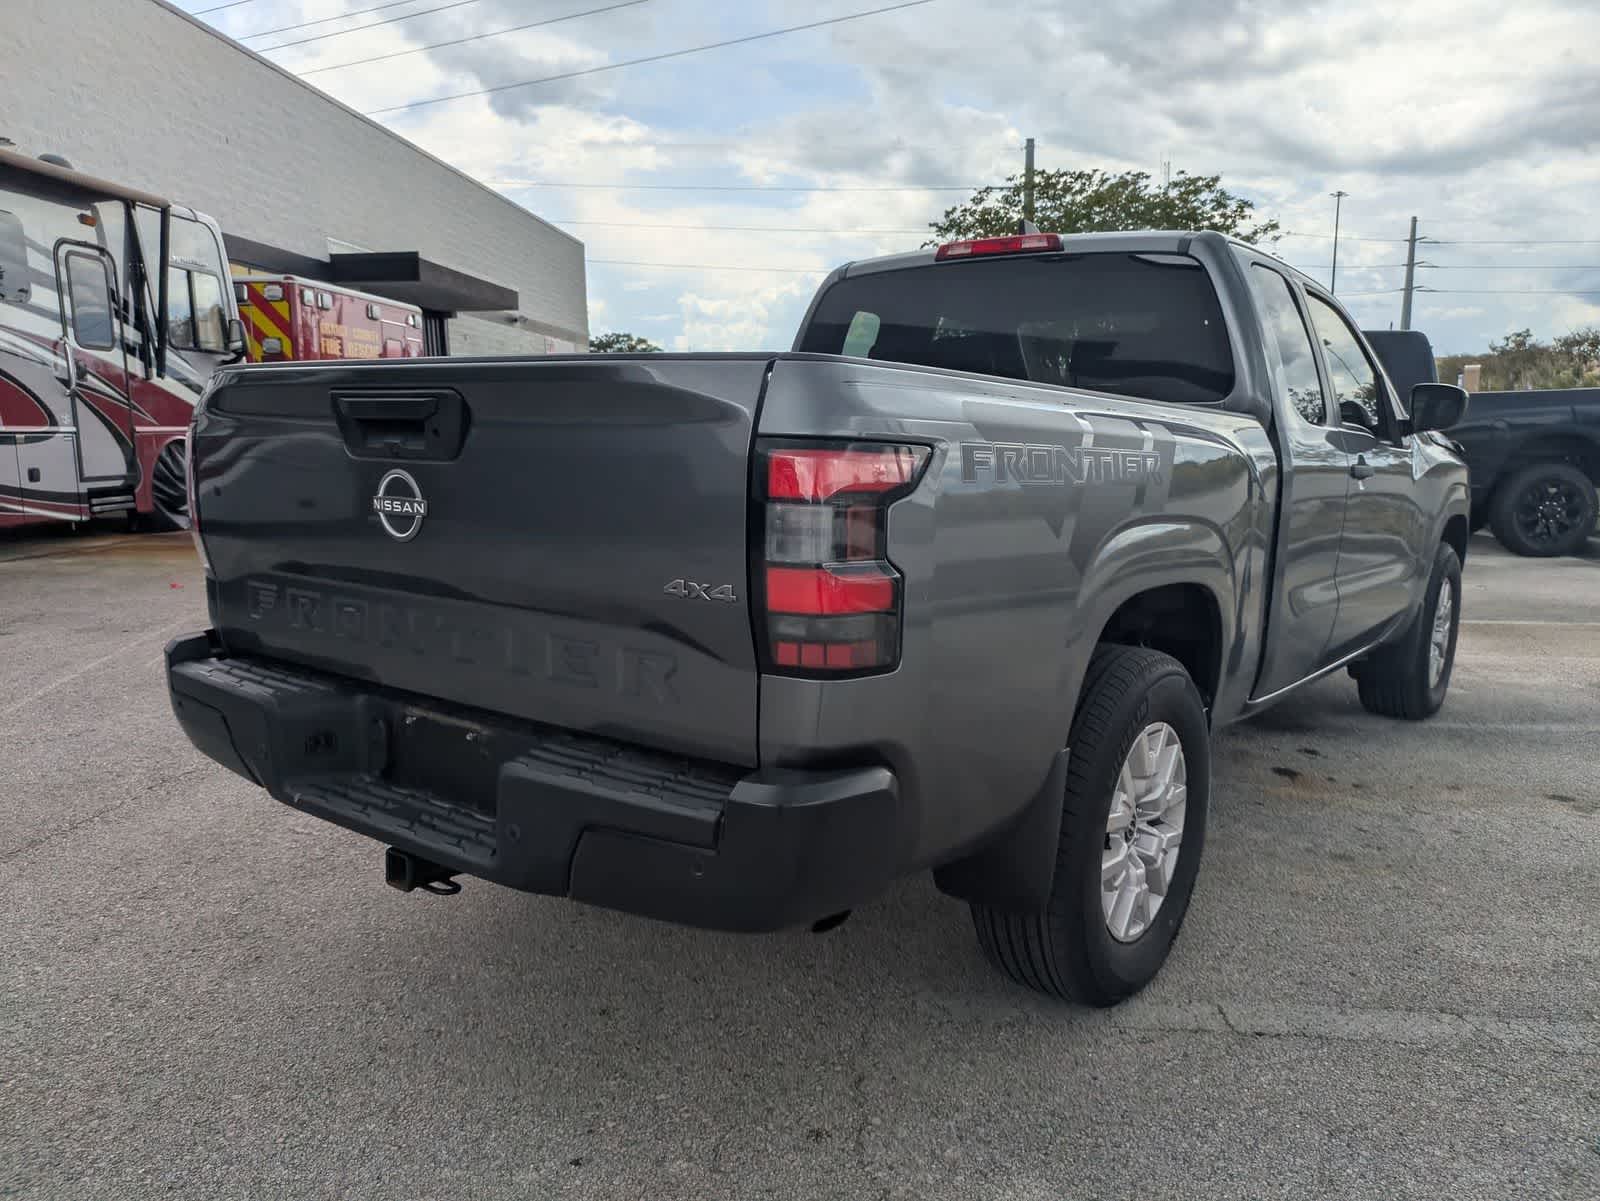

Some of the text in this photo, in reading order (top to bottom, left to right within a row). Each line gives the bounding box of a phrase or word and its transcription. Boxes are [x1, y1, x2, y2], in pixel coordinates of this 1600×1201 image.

[320, 337, 342, 356] FIRE
[960, 441, 1161, 487] FRONTIER
[373, 498, 425, 514] NISSAN
[247, 579, 680, 703] FRONTIER
